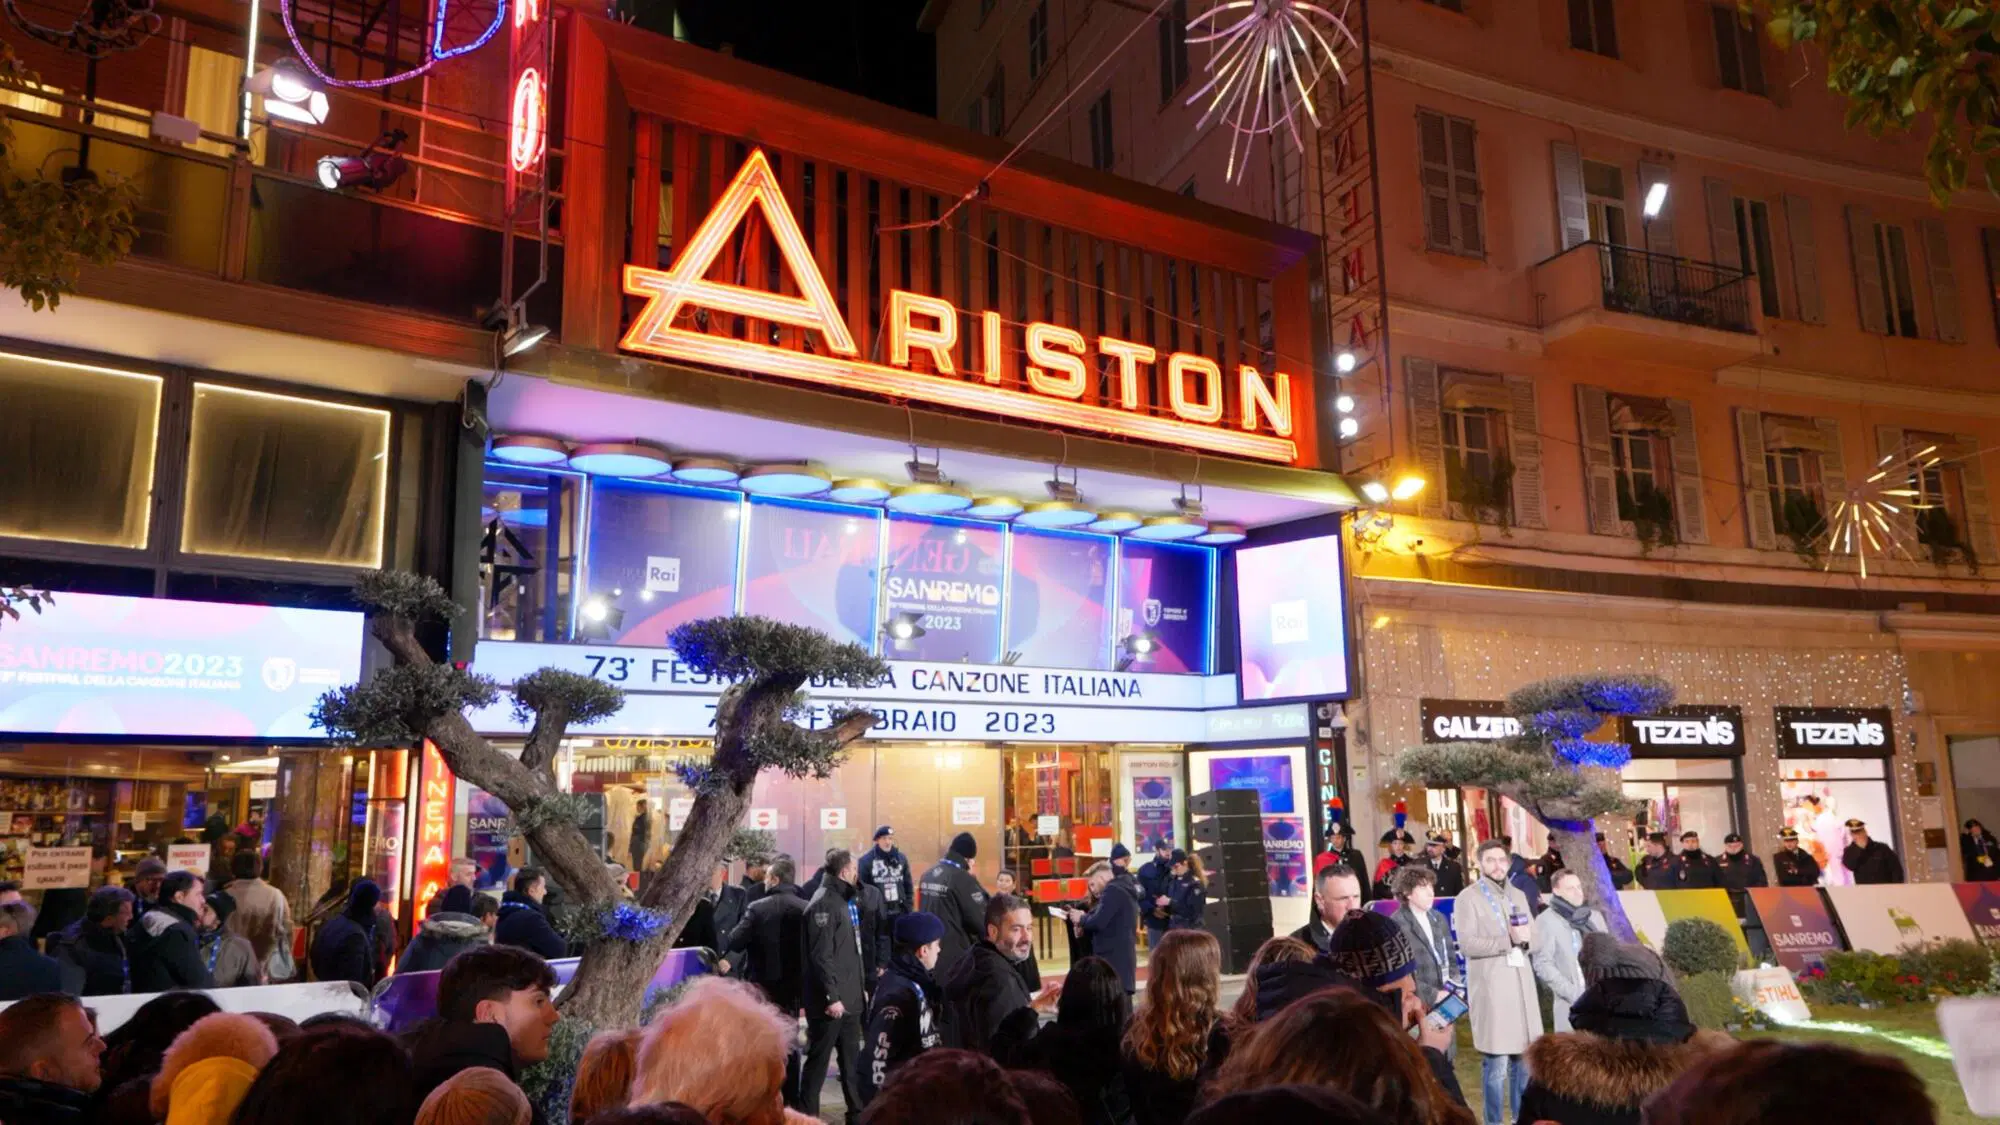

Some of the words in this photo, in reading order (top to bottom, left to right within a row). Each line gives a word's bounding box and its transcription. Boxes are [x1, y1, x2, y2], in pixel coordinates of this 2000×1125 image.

[620, 147, 1296, 450] ARISTON
[650, 566, 676, 582] Rai
[888, 576, 1000, 606] SANREMO
[925, 615, 962, 631] 2023
[912, 669, 1030, 694] CANZONE
[1044, 674, 1143, 698] ITALIANA
[810, 708, 956, 732] FBRAIO
[985, 711, 1056, 734] 2023
[1433, 716, 1526, 739] CALZED
[1134, 799, 1172, 809] SANREMO
[1319, 748, 1334, 852] CINE
[1772, 931, 1834, 947] SANREMO
[1757, 984, 1800, 1004] STIHL
